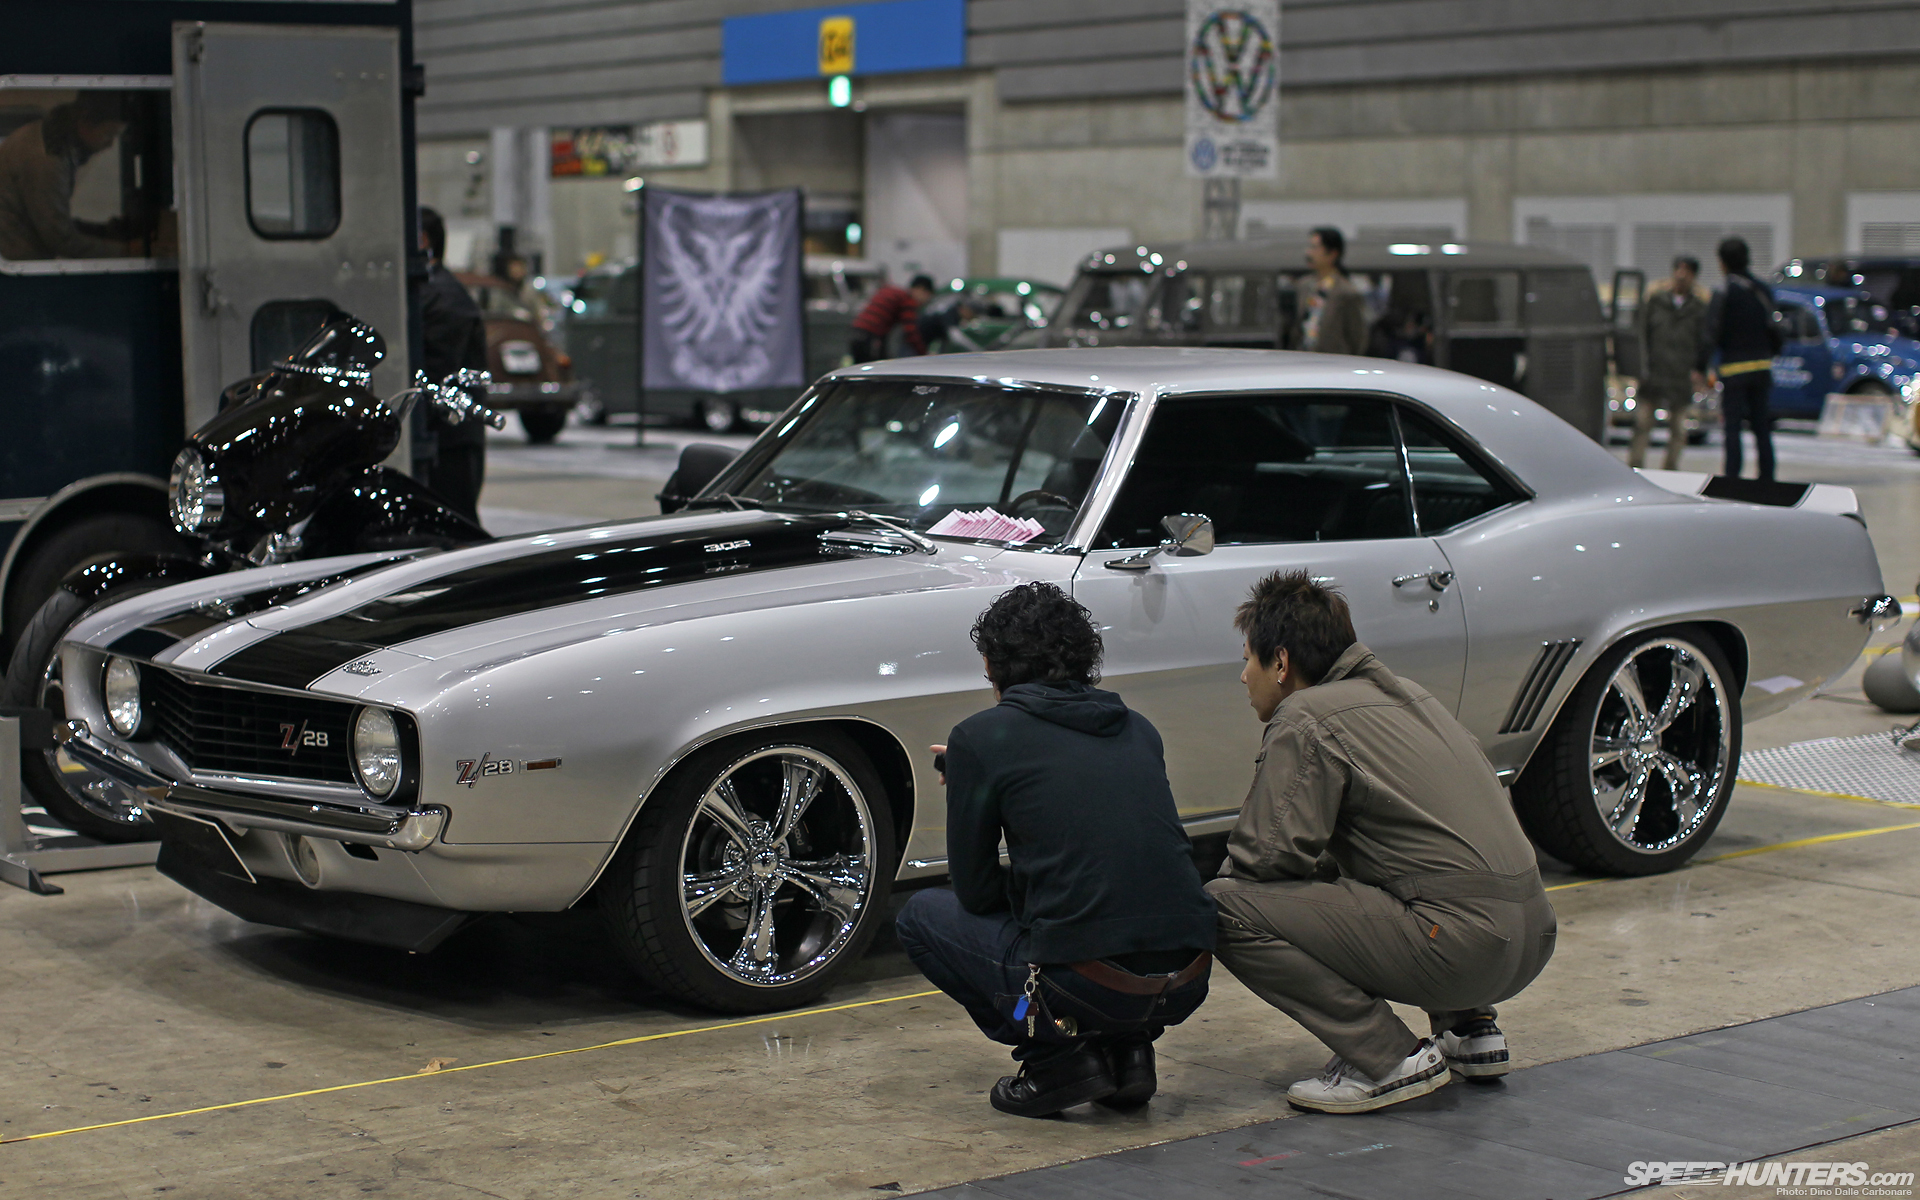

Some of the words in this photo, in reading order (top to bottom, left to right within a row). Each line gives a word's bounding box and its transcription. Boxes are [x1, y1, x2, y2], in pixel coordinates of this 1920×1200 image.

[703, 540, 752, 553] 302
[279, 719, 329, 756] Z/28
[456, 752, 515, 788] Z/28
